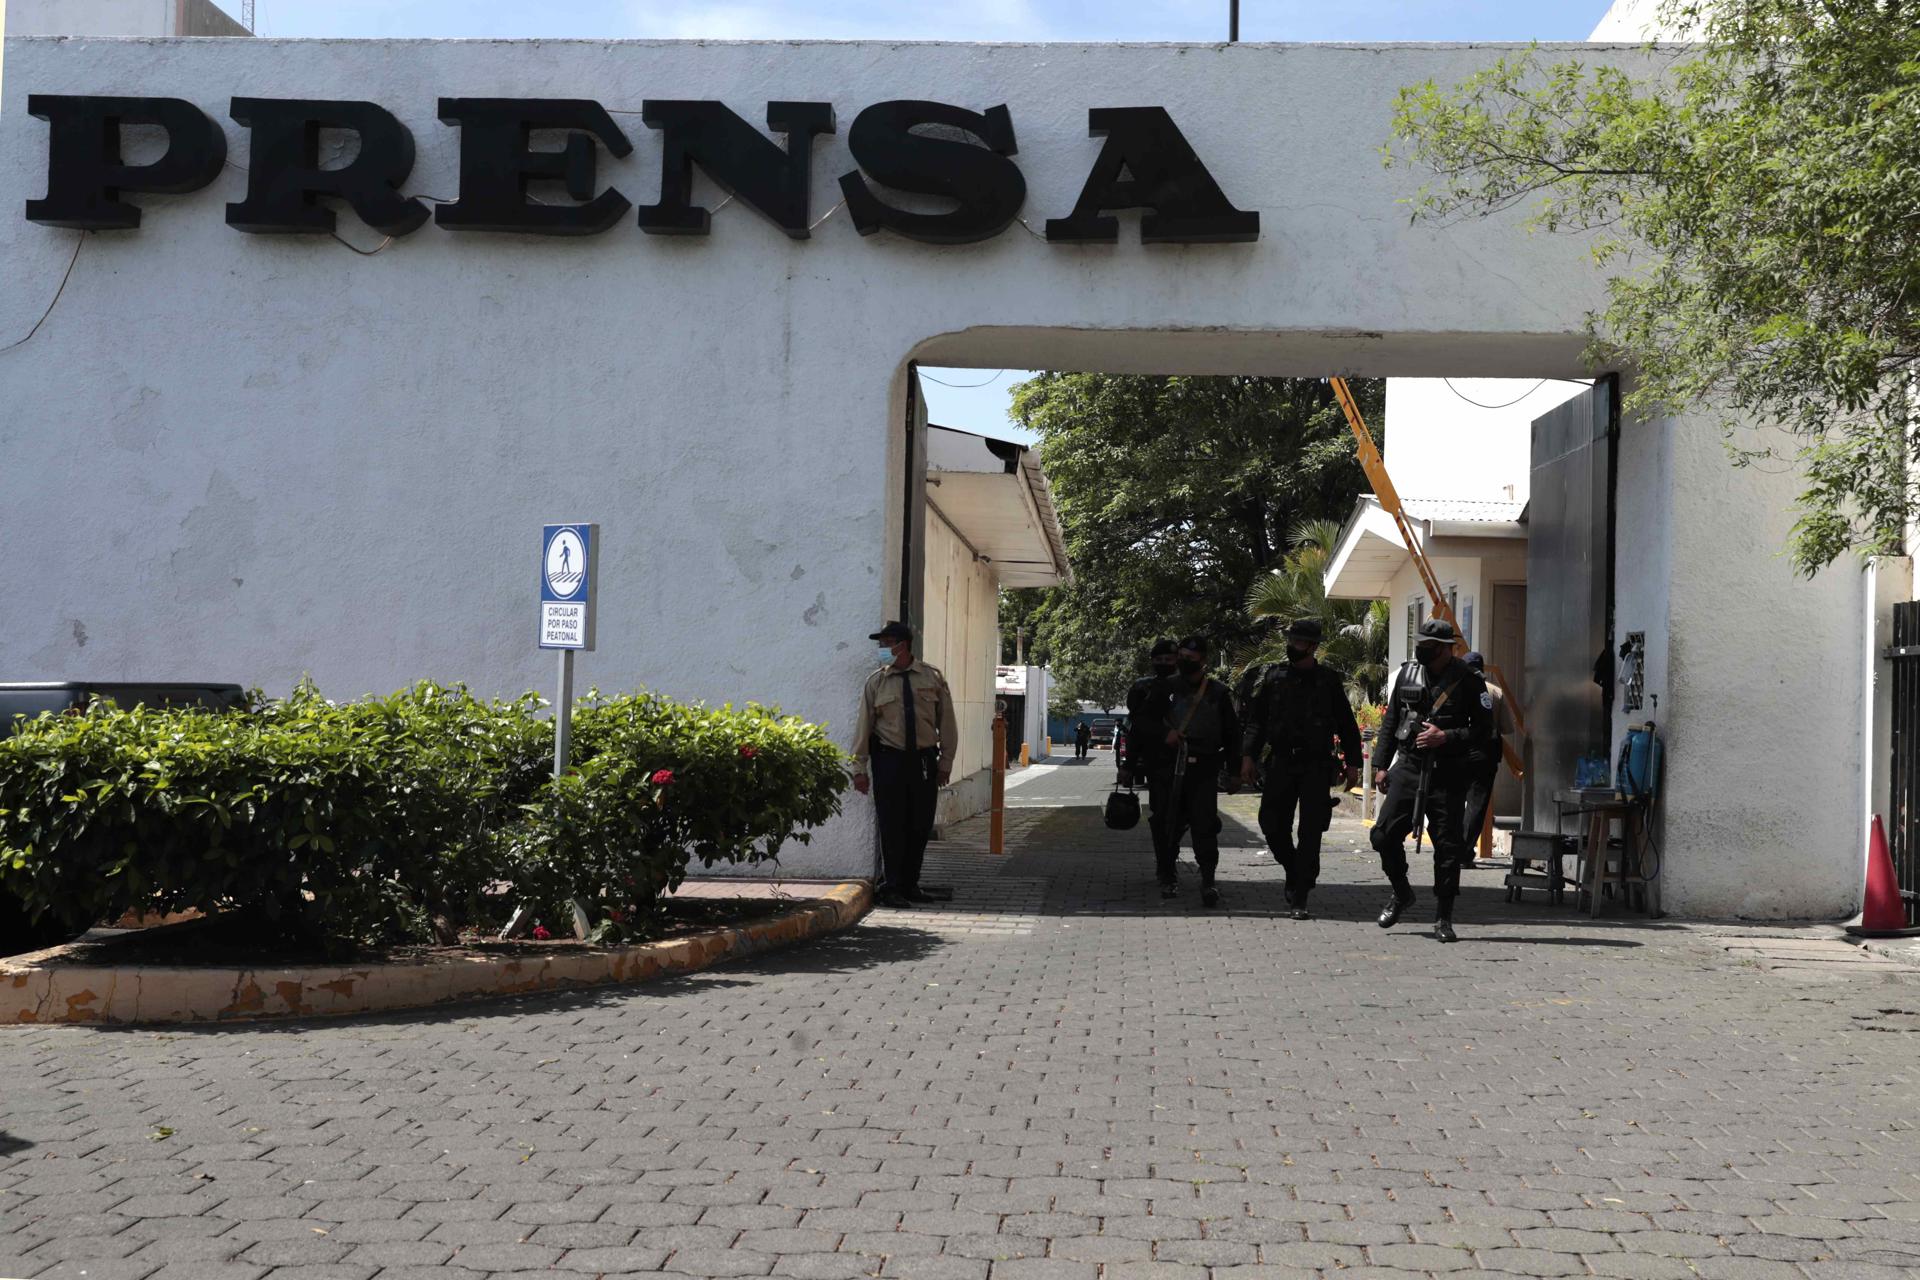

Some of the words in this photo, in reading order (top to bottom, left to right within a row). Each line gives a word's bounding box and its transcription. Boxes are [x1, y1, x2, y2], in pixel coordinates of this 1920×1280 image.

[26, 94, 1260, 245] PRENSA
[548, 607, 578, 616] CIRCULAR
[548, 619, 560, 628] POR
[561, 619, 577, 629] PASO
[546, 631, 577, 641] PEATONAL
